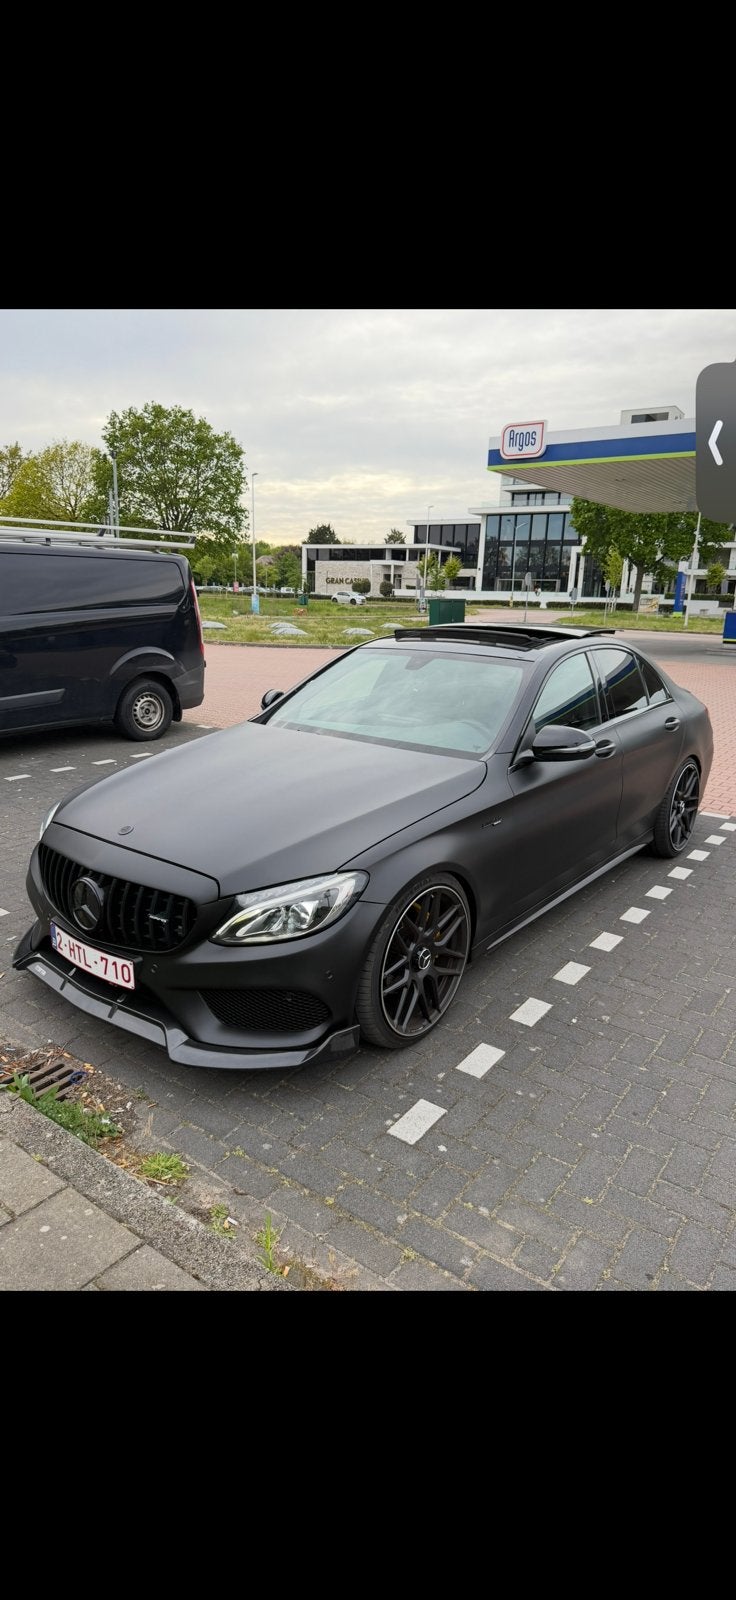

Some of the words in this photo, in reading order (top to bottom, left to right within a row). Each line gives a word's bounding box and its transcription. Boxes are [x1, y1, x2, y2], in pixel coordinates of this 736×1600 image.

[508, 429, 537, 452] Argos
[325, 577, 344, 585] GRAN
[56, 931, 131, 984] 2-HTL-710
